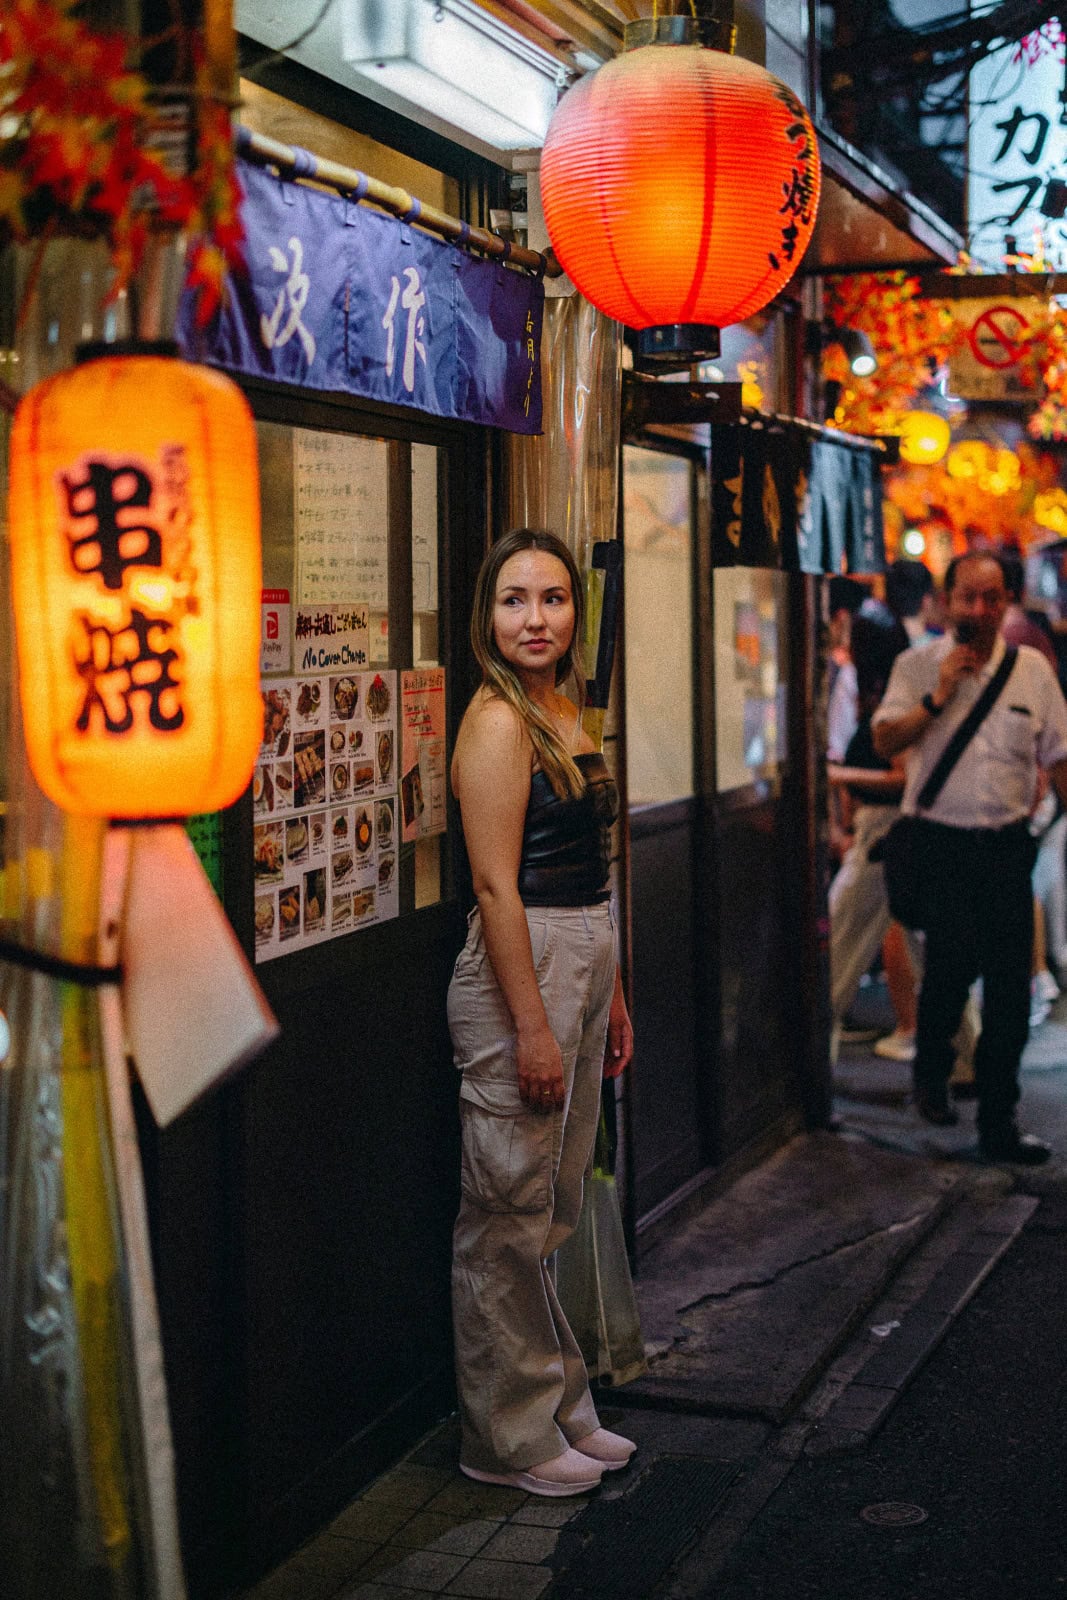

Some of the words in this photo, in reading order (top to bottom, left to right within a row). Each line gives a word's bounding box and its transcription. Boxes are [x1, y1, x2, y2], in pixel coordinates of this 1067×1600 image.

[61, 463, 185, 733] 串焼
[302, 646, 317, 669] No
[319, 648, 341, 668] Cover
[342, 644, 366, 664] Charge
